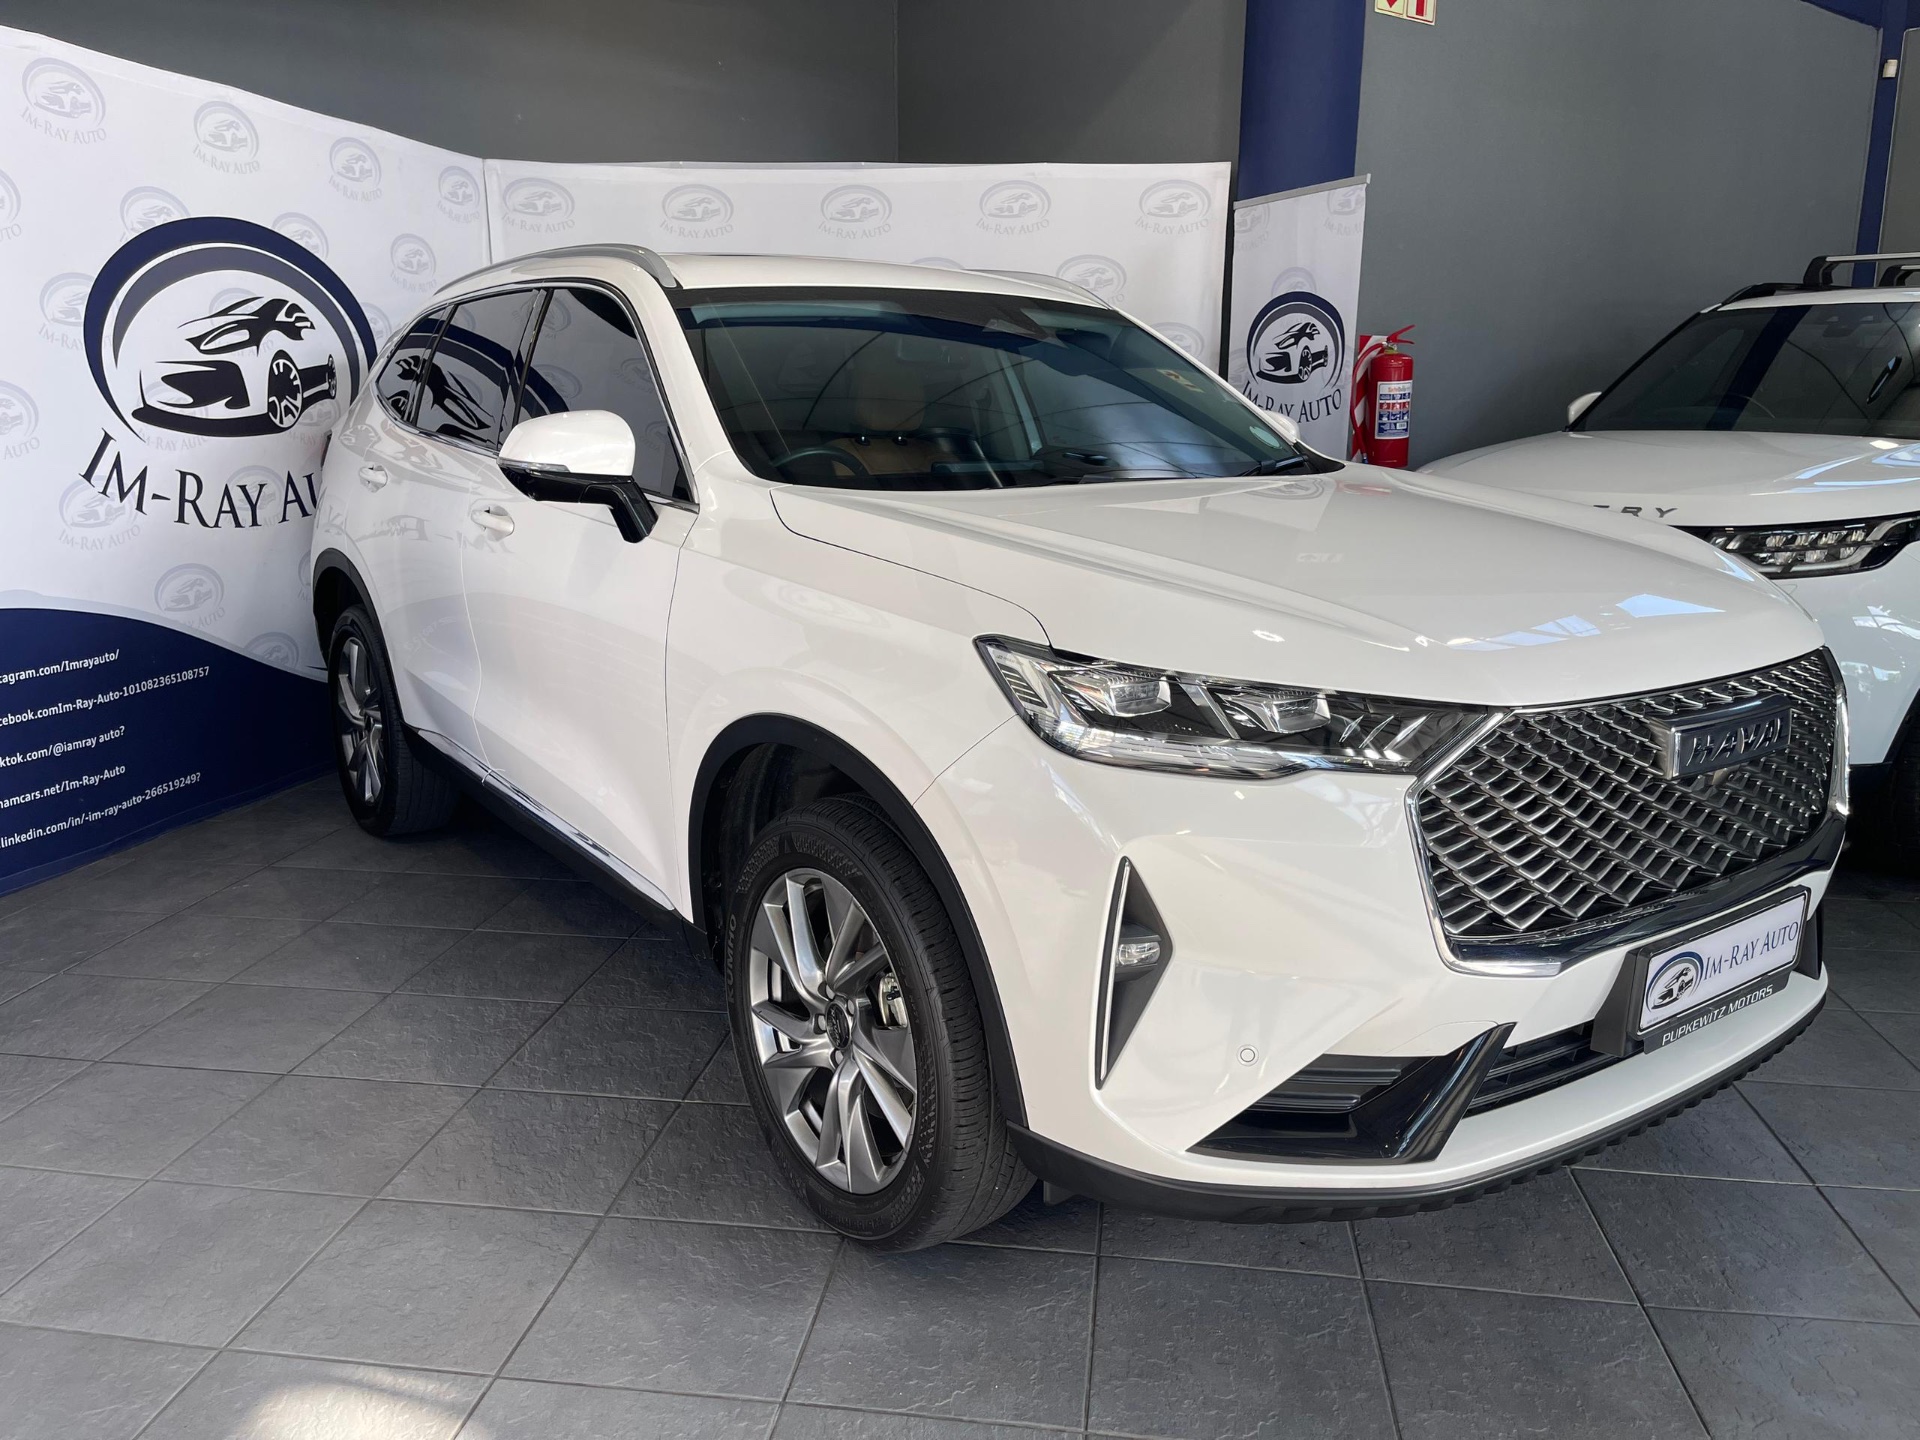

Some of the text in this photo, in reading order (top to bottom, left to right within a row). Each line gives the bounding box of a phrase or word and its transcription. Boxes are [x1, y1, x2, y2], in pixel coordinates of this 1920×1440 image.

[73, 127, 107, 145] AUTO
[233, 160, 260, 174] AUTO
[544, 219, 576, 234] AUTO
[703, 224, 734, 239] AUTO
[860, 223, 892, 239] AUTO
[1018, 218, 1050, 235] AUTO
[1177, 218, 1209, 235] AUTO
[1297, 388, 1342, 423] AUTO
[77, 427, 267, 529] IM-RAY
[108, 524, 141, 550] AUTO
[1703, 921, 1799, 980] IM-RAY AUTO
[1661, 984, 1774, 1046] PUPKEWITZ MOTORS
